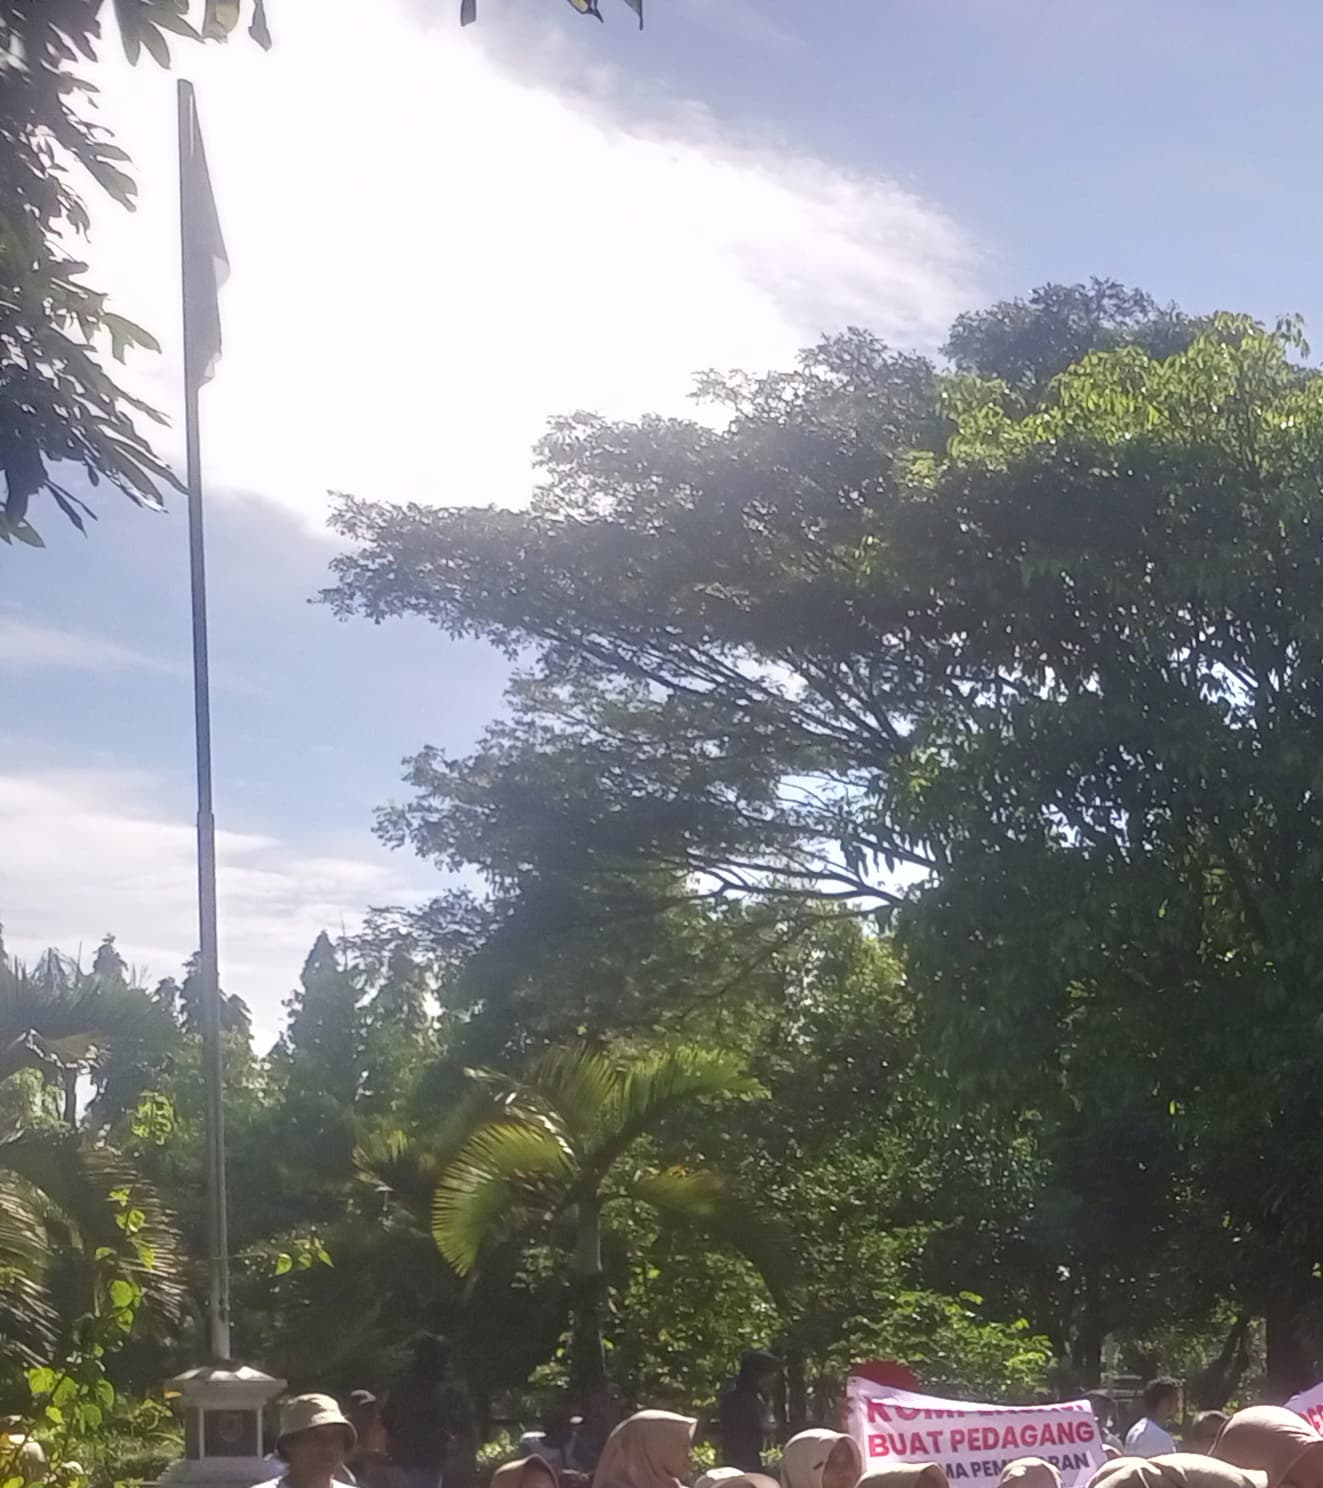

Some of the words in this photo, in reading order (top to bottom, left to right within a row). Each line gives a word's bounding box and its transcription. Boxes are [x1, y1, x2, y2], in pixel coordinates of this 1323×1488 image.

[868, 1430, 943, 1457] BUAT
[949, 1421, 1095, 1452] PEDAGANG
[971, 1452, 1090, 1478] PEMRAN
